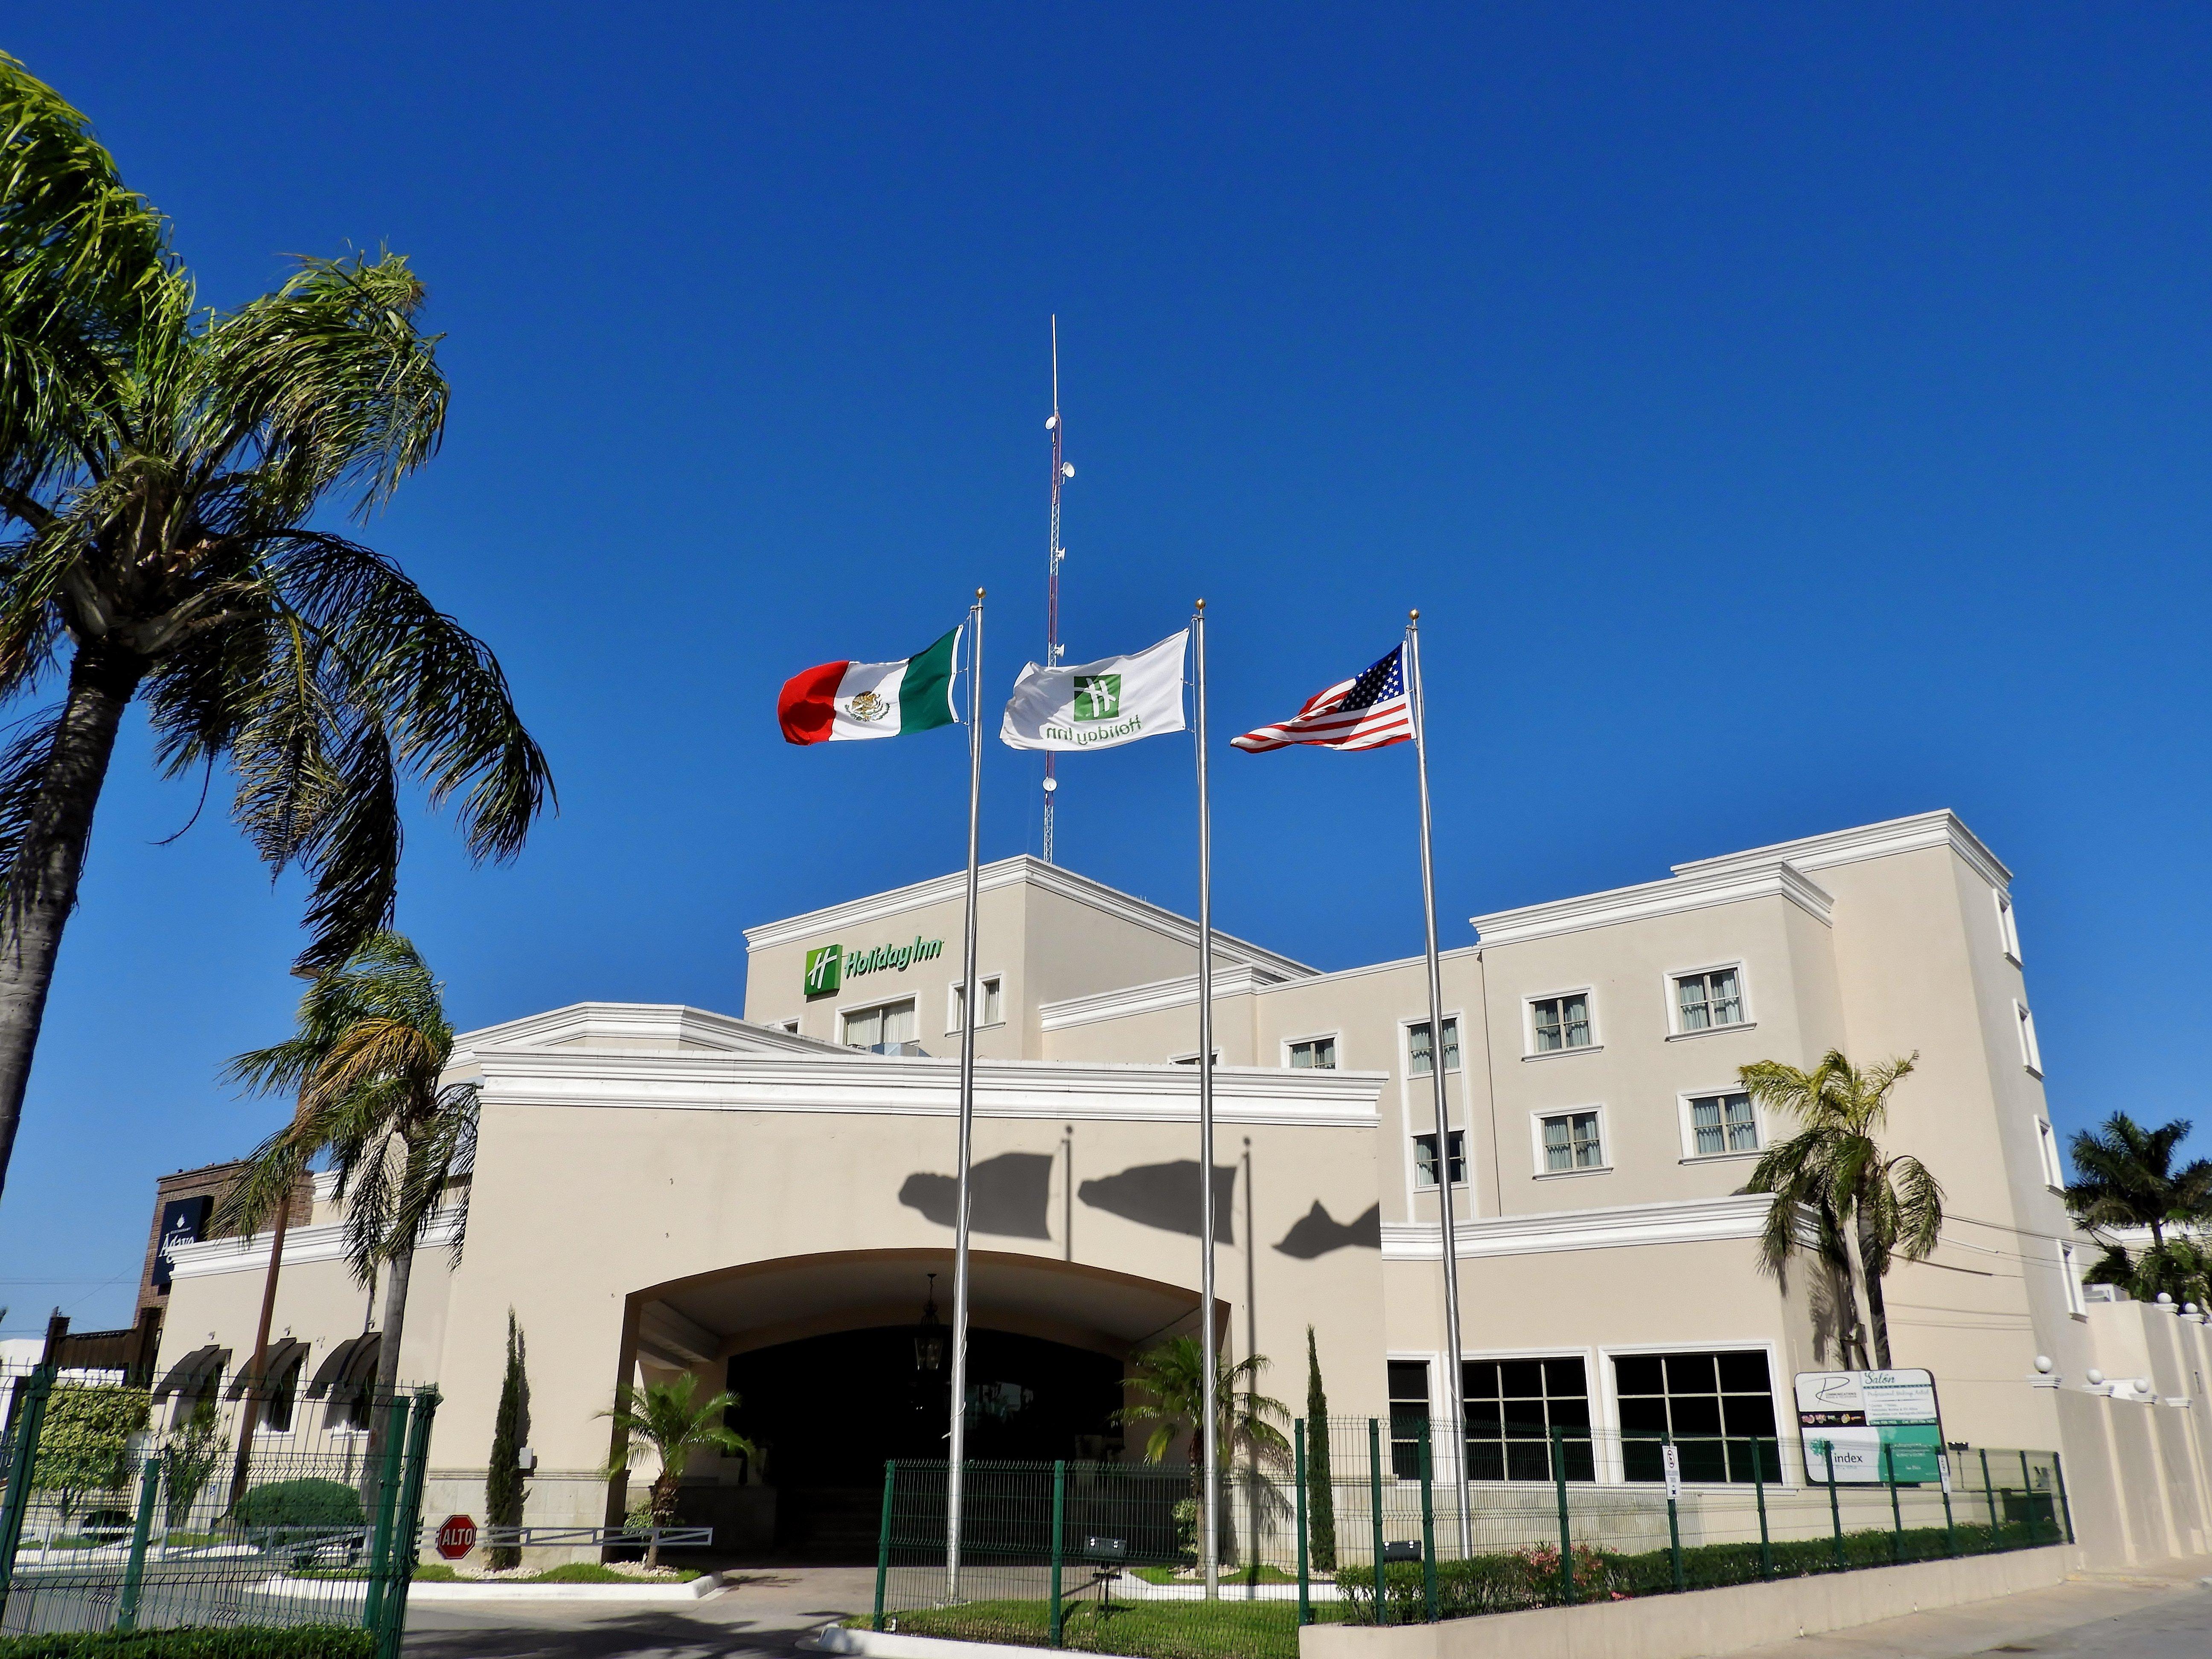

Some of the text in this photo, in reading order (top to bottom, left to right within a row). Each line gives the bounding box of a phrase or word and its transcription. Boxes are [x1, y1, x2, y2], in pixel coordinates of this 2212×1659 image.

[844, 935, 943, 978] Holiday Inn
[1834, 1452, 1863, 1463] index
[442, 1528, 473, 1545] ALTO
